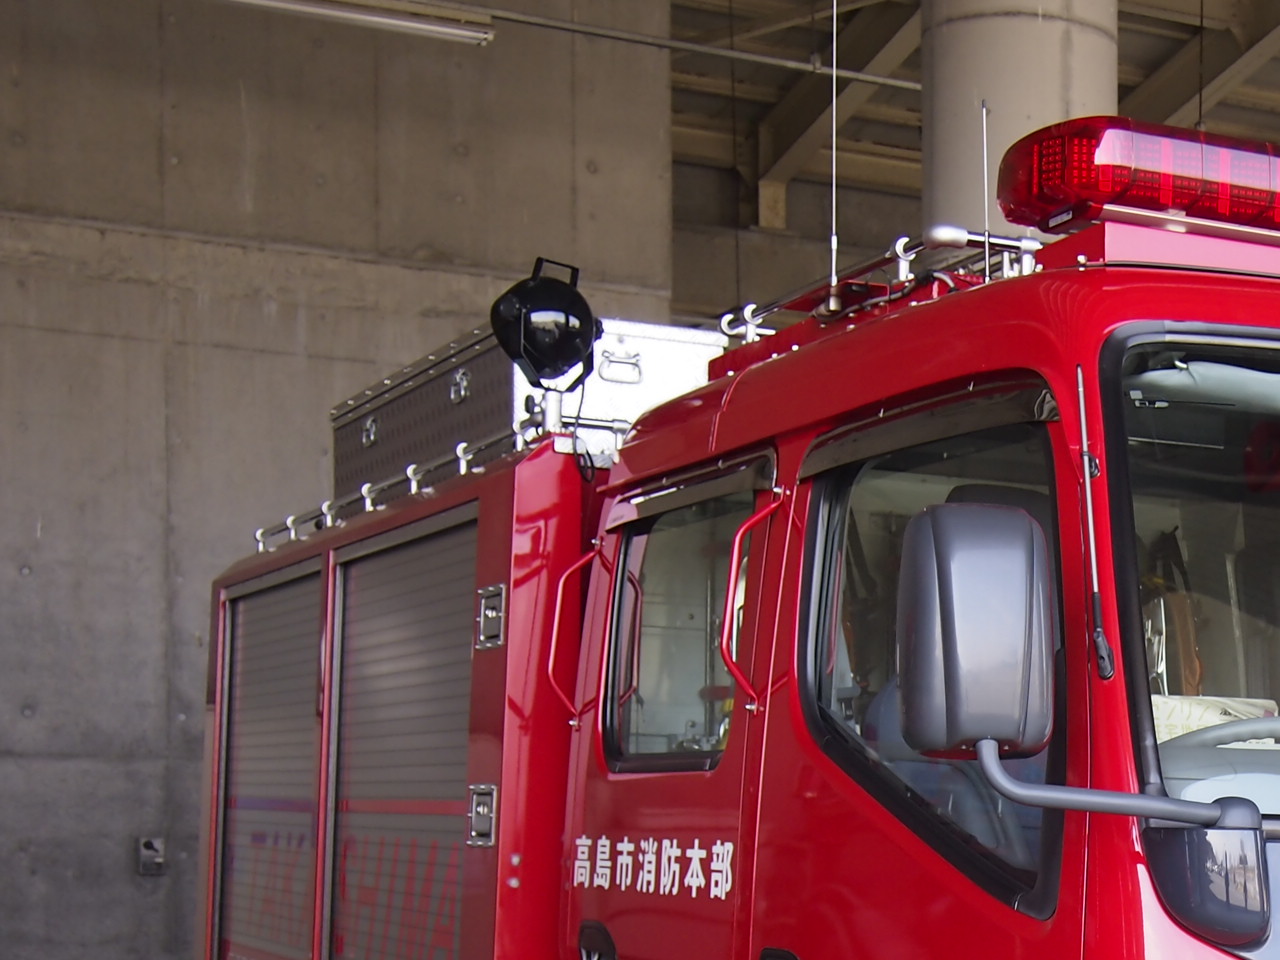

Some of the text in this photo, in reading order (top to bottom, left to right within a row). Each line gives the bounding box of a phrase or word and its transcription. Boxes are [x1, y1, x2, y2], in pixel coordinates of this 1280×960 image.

[573, 835, 734, 900] 高島市消防本部
